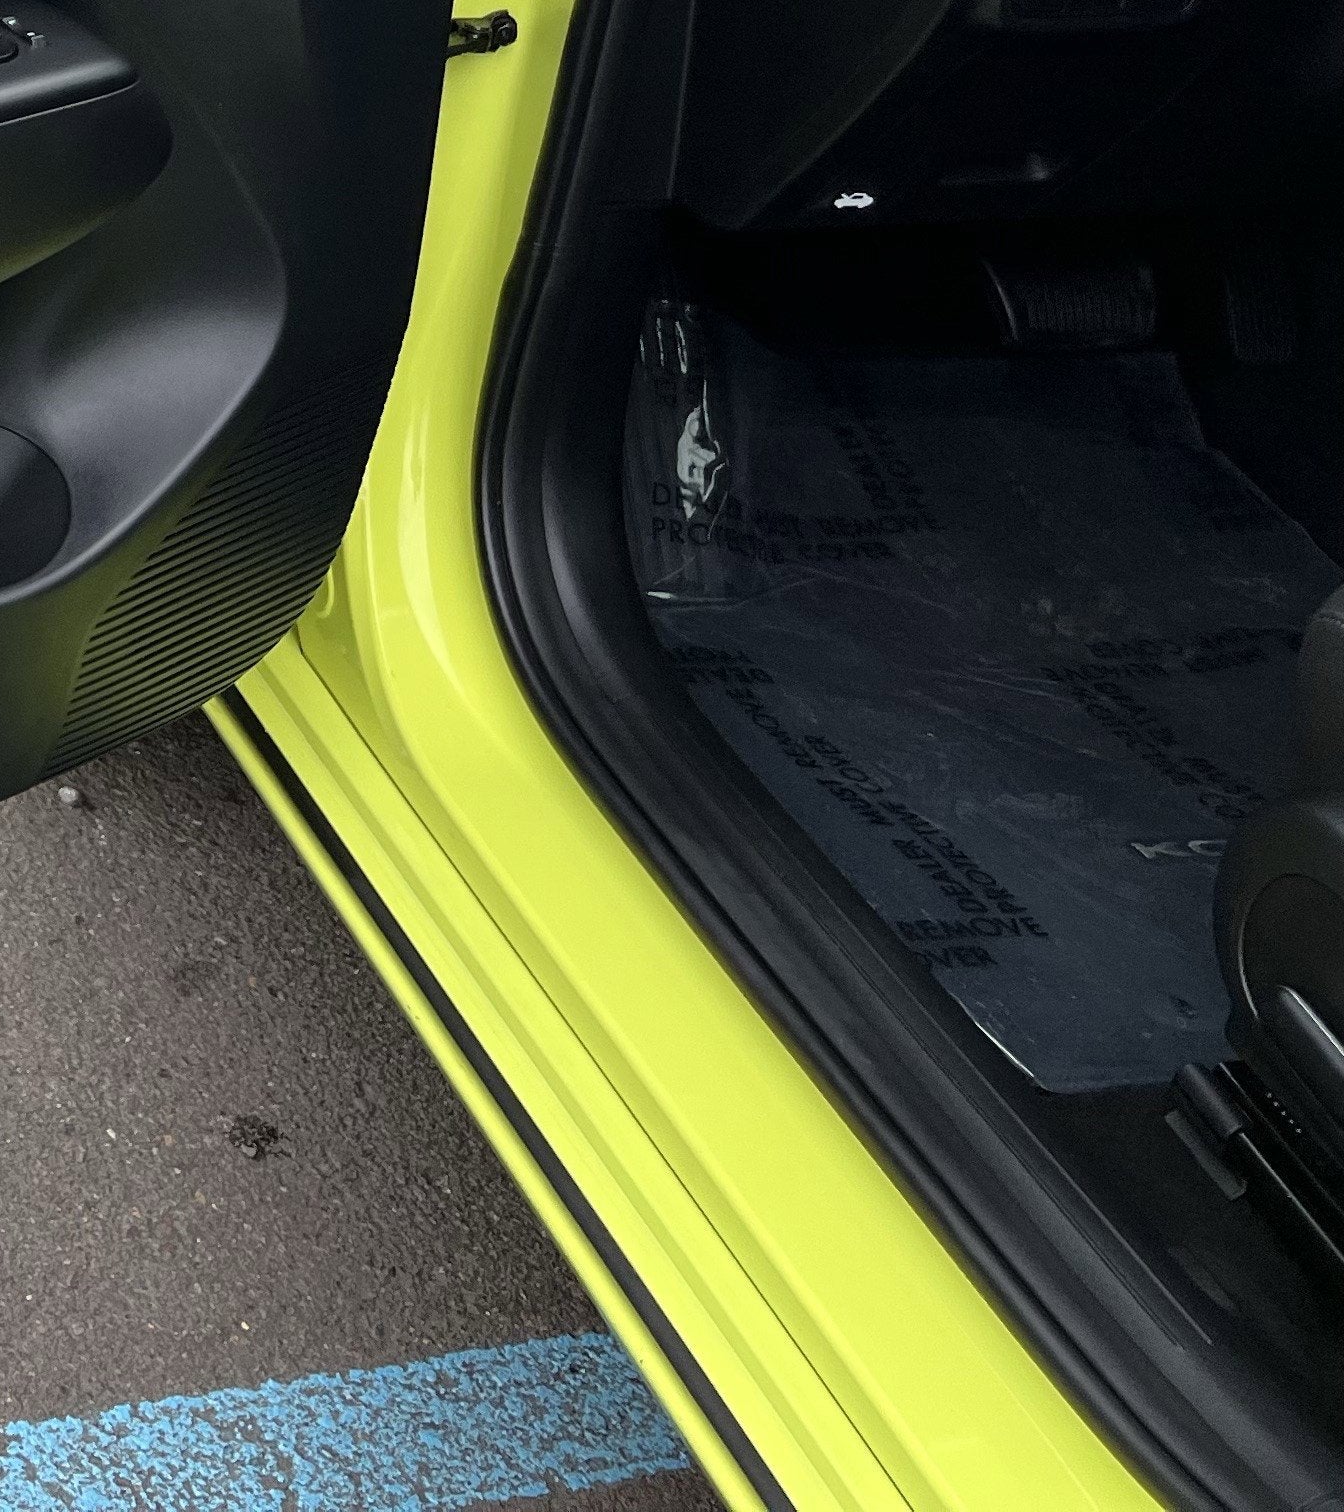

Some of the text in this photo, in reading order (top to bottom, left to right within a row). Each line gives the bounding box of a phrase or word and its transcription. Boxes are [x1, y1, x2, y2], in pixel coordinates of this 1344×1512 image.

[804, 733, 884, 795] COVER
[726, 687, 988, 914] DEALER MUST REMOVE
[896, 916, 1050, 942] REMOVE
